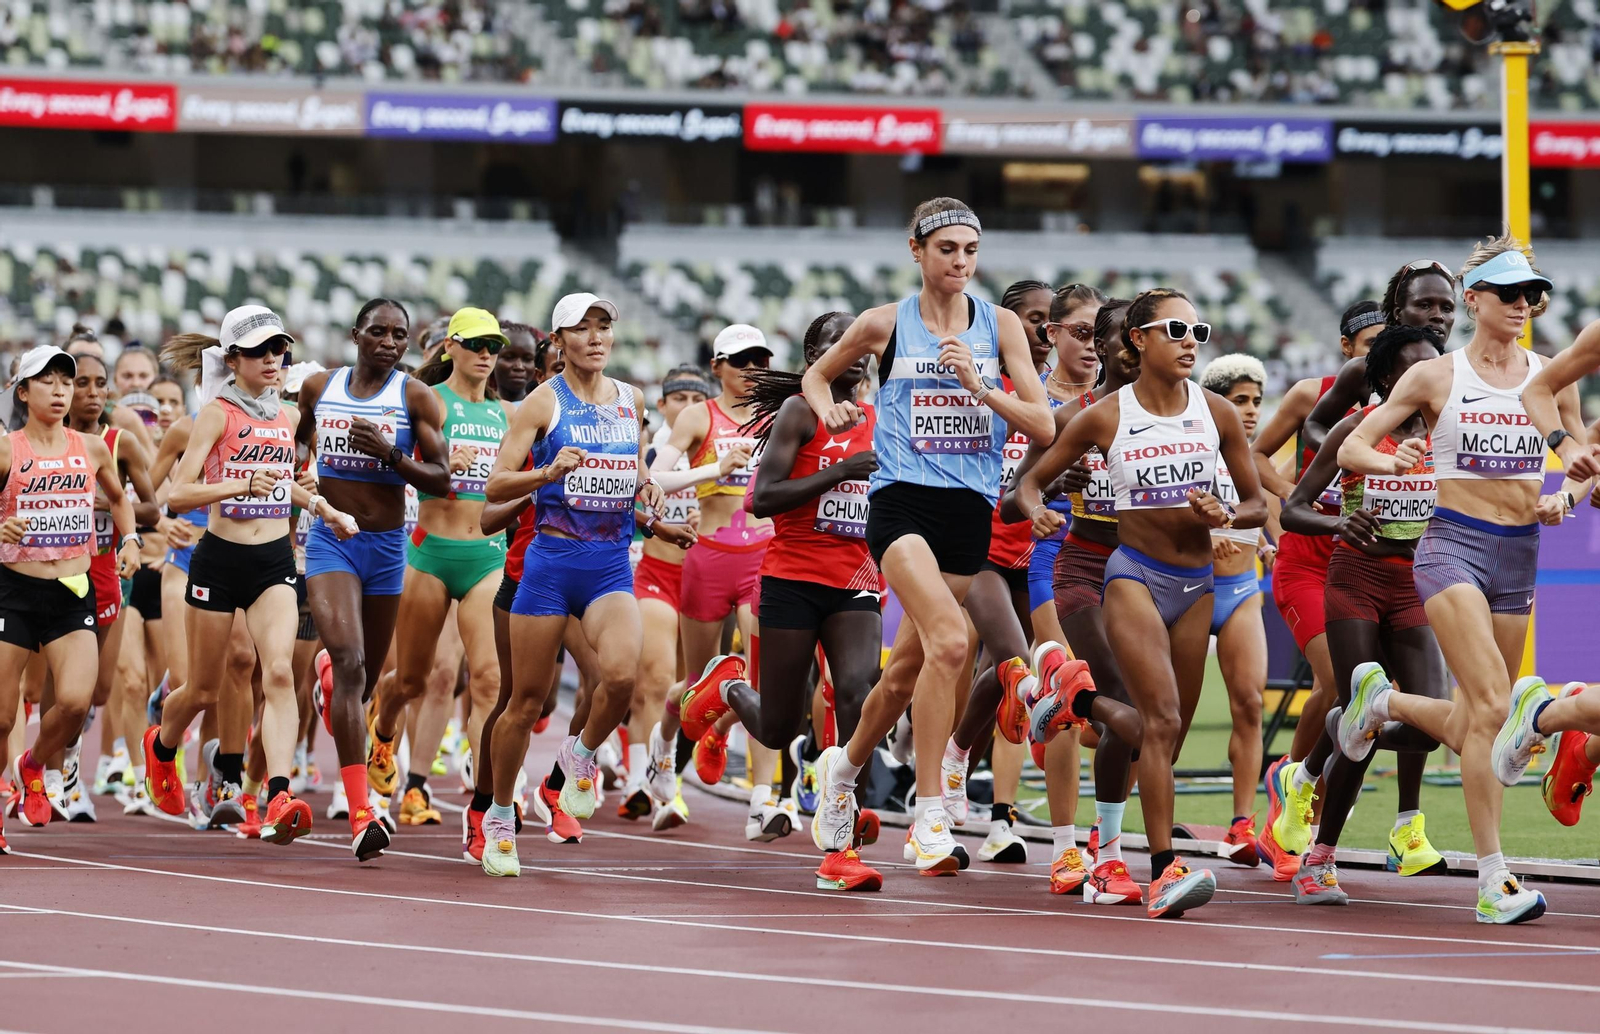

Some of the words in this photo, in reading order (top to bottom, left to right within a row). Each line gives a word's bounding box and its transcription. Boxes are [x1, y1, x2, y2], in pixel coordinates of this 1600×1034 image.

[915, 414, 990, 435] PATERNAIN
[229, 444, 295, 464] JAPAN
[935, 440, 989, 449] TOKYO25
[1123, 442, 1212, 462] HONDA
[1462, 433, 1544, 455] McCLAIN
[1136, 461, 1204, 487] KEMP
[1480, 460, 1539, 469] TOKYO25
[22, 474, 87, 494] JAPAN
[568, 475, 635, 495] GALBADRAKH
[19, 498, 91, 510] HONDA
[241, 507, 290, 515] TOKYO25
[1038, 700, 1063, 733] BROOKS
